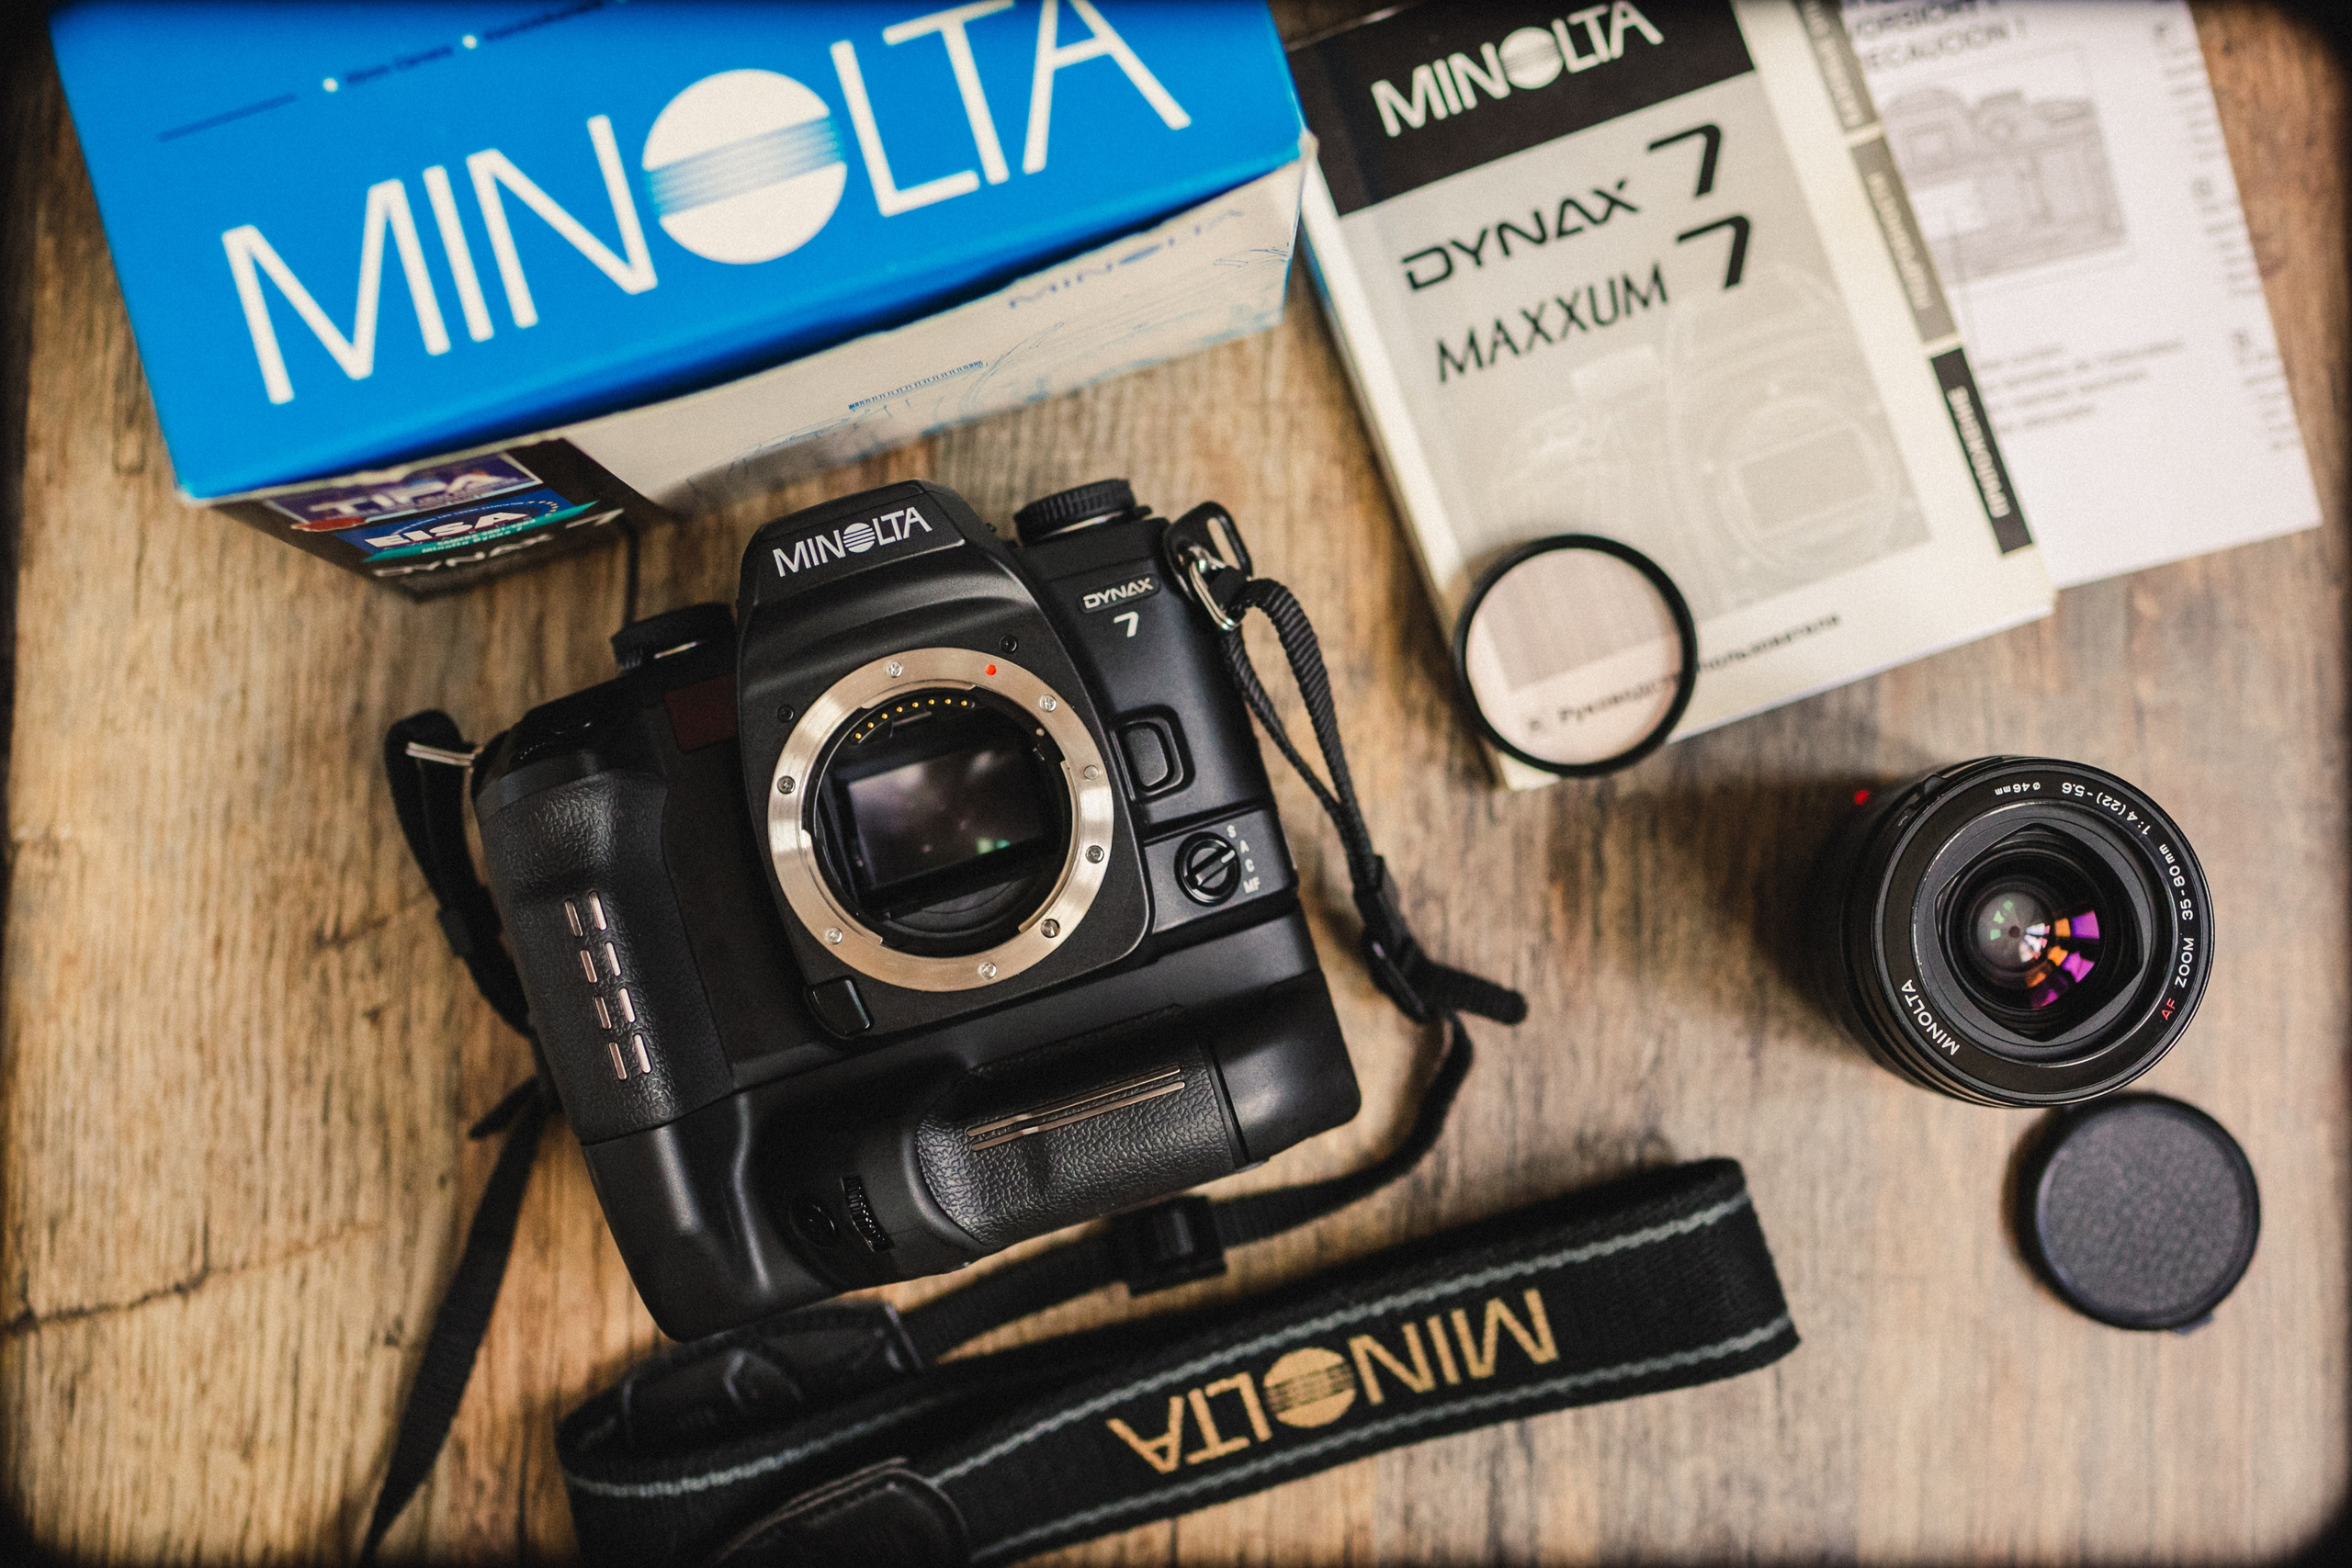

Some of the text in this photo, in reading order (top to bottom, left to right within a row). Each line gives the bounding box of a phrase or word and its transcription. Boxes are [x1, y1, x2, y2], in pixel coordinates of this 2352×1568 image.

[1371, 0, 1665, 138] MINOLTA
[221, 0, 1193, 405] MINOLTA
[1401, 123, 1723, 291] DYNAX 7
[1437, 214, 1752, 385] MAXXUM 7
[364, 512, 532, 548] EISA
[772, 506, 933, 578] MINOLTA
[1082, 577, 1154, 609] DYNAX
[1113, 611, 1139, 638] 7
[1227, 824, 1238, 839] S
[1239, 840, 1250, 854] A
[1242, 875, 1261, 895] MF
[2174, 937, 2195, 988] ZOOM
[1901, 978, 1961, 1056] MINOLTA
[2161, 997, 2176, 1021] AF
[1107, 1289, 1559, 1473] MINOLTA
